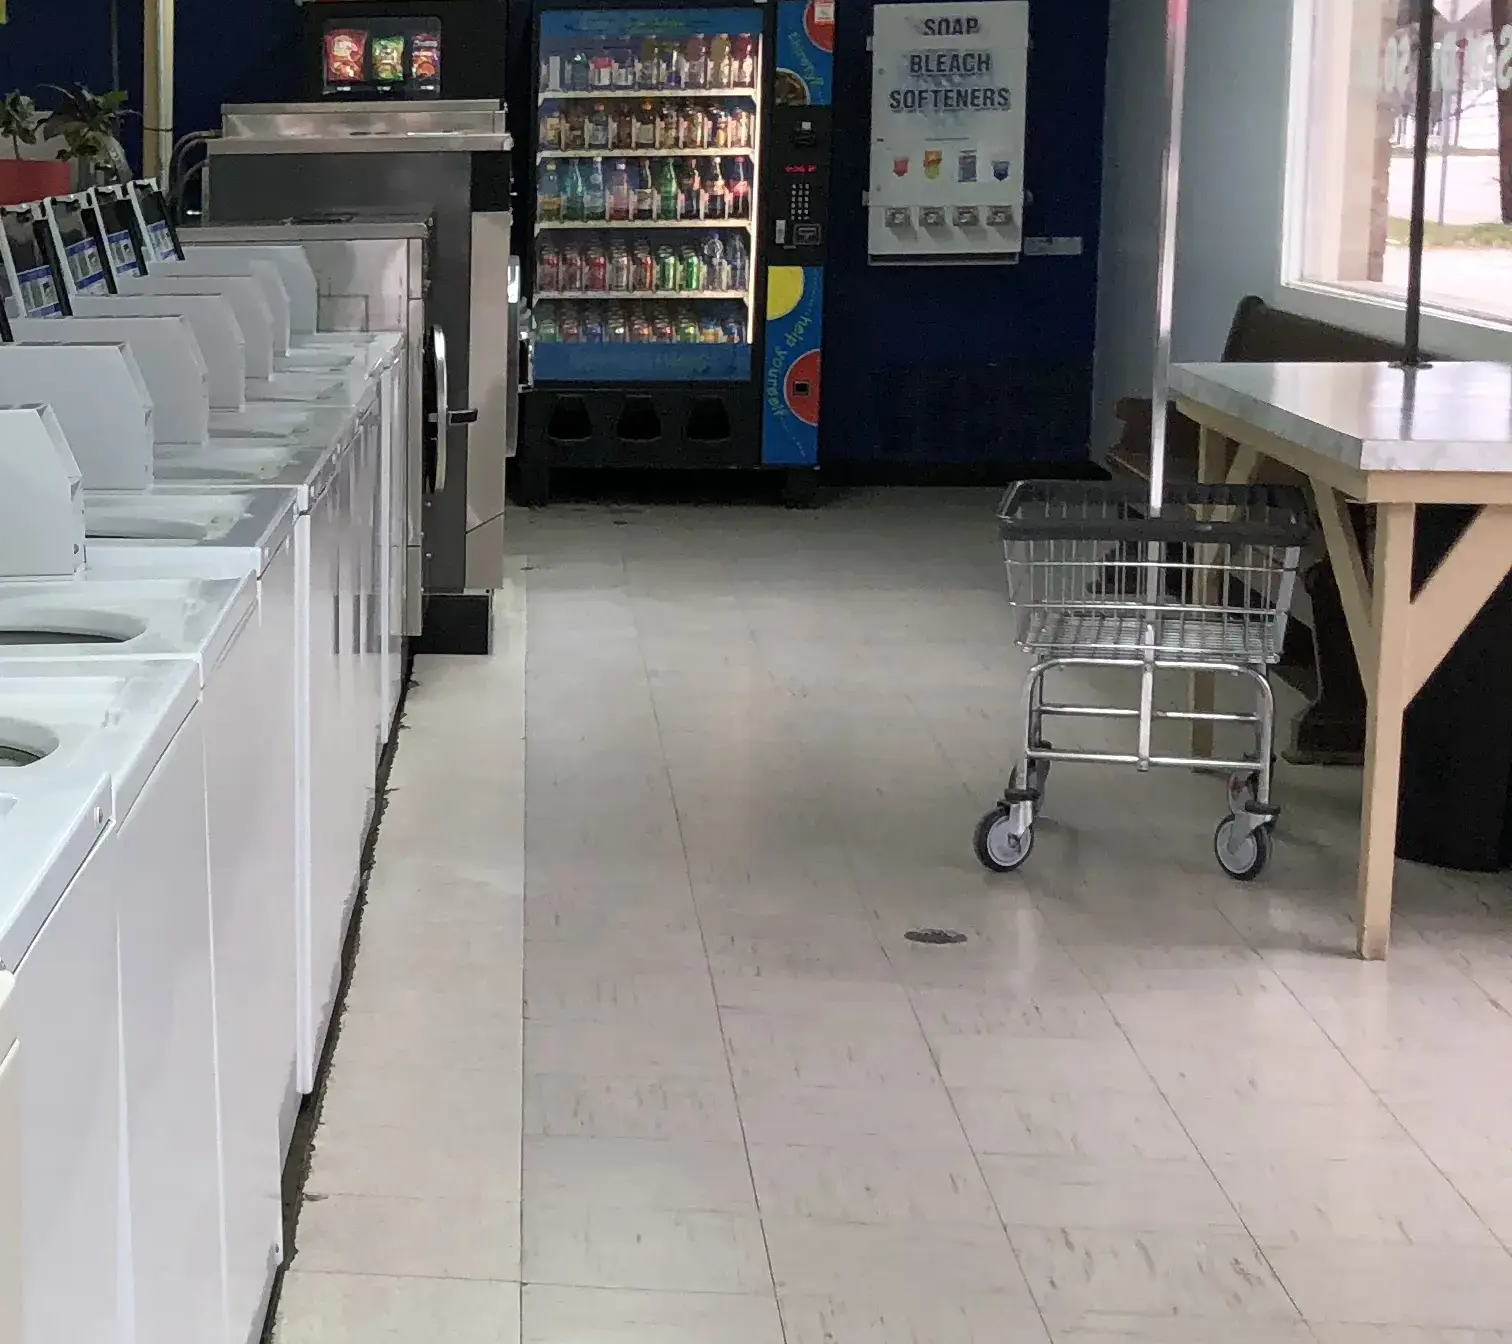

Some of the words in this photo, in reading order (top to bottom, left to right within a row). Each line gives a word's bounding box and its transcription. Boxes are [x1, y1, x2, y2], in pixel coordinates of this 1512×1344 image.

[923, 17, 980, 36] SOAP
[909, 53, 991, 74] BLEACH
[889, 88, 1012, 109] SOFTENERS
